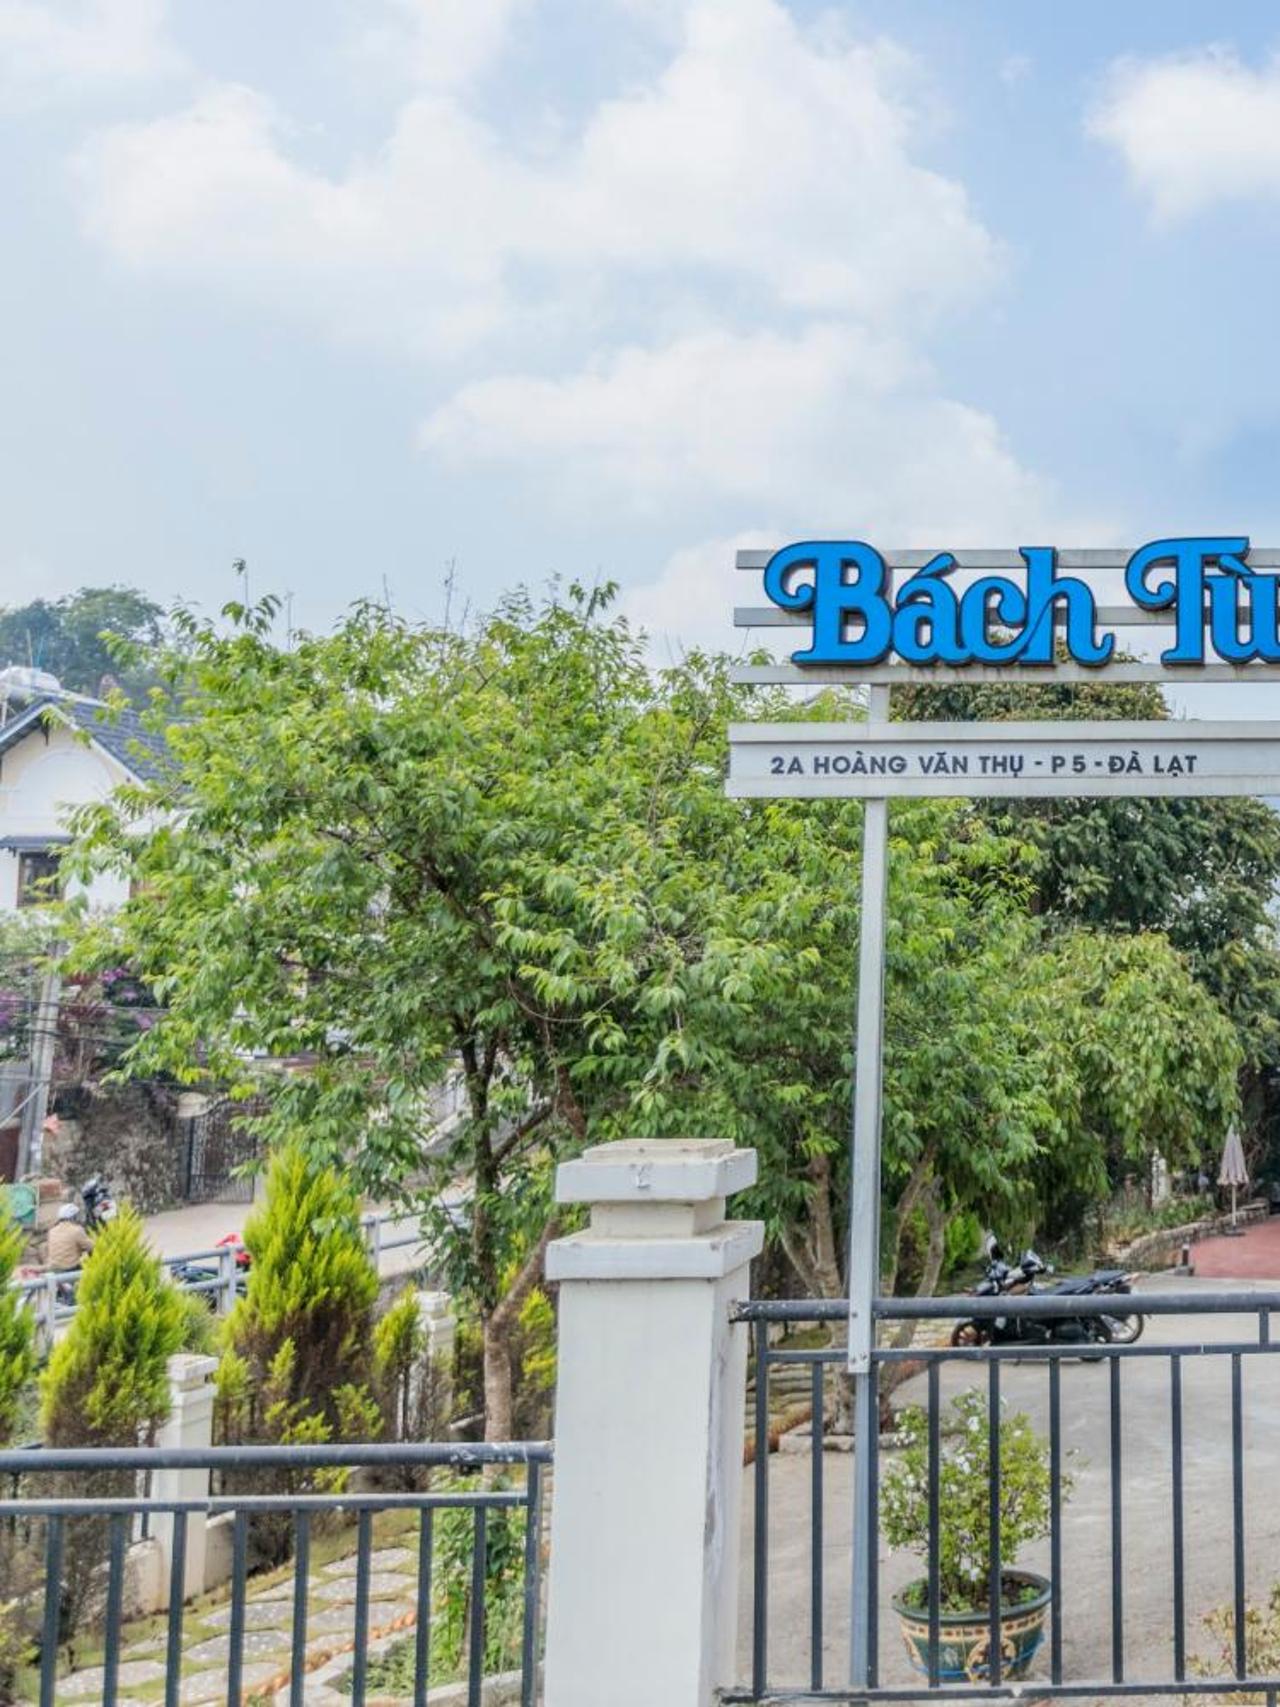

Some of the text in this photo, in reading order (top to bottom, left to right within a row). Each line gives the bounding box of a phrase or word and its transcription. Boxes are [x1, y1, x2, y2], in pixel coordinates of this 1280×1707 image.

[764, 539, 1114, 664] Bách
[771, 756, 804, 774] 2A
[814, 751, 907, 774] HOÀNG
[918, 751, 968, 774] VĂN
[978, 756, 1023, 777] THỤ
[1108, 751, 1143, 774] ĐÀ
[1154, 756, 1197, 777] LẠT
